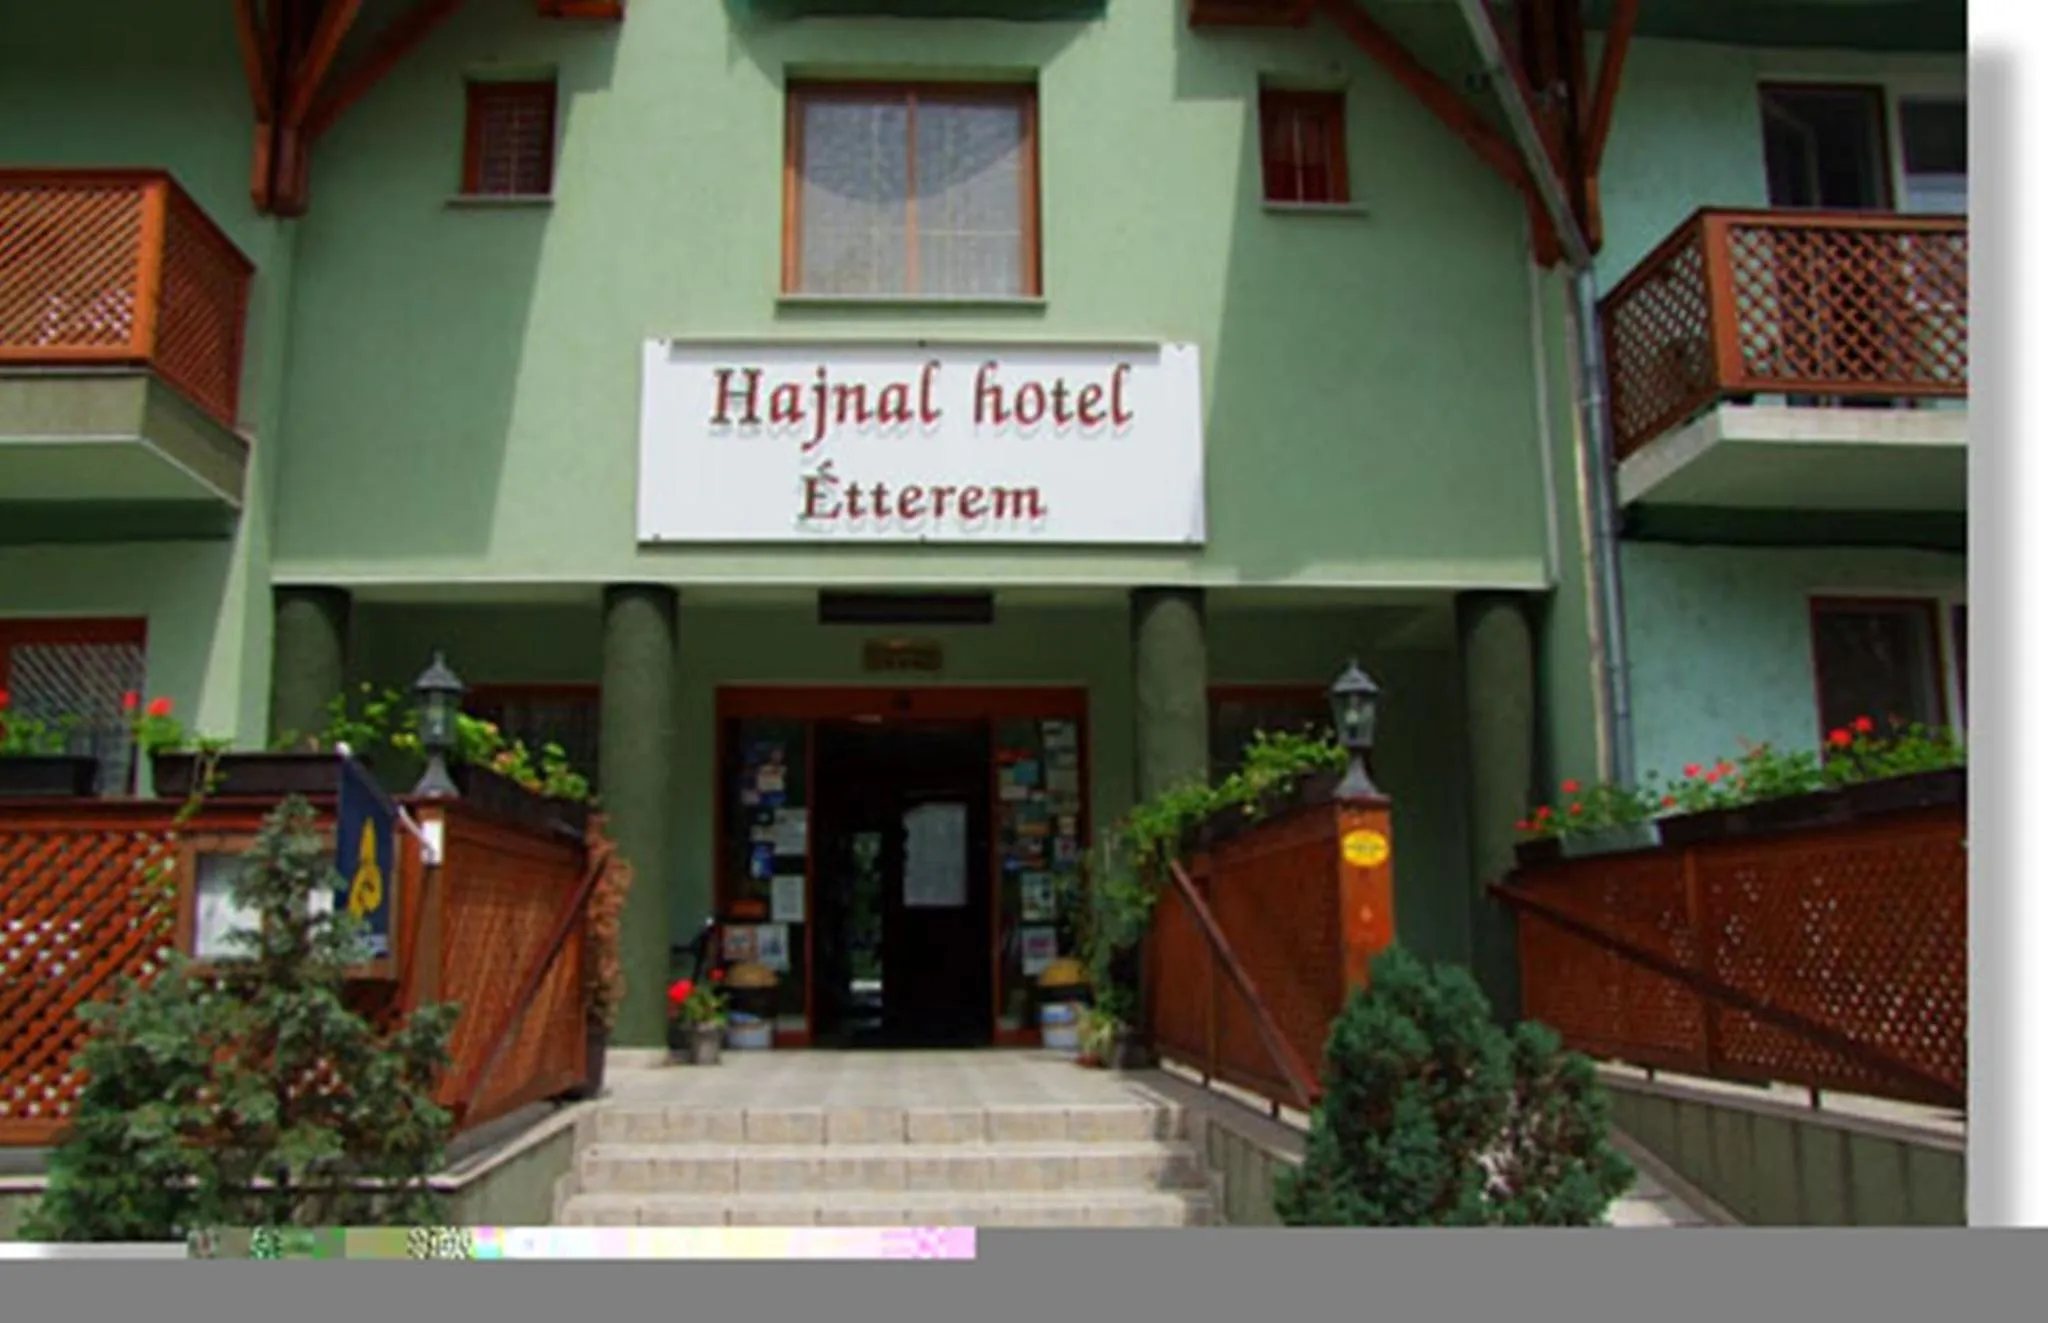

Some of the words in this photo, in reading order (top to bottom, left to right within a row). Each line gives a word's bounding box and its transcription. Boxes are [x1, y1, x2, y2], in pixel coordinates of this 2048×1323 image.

[709, 361, 941, 451] Hajnal
[973, 361, 1133, 427] hotel
[801, 460, 1047, 520] Étterem
